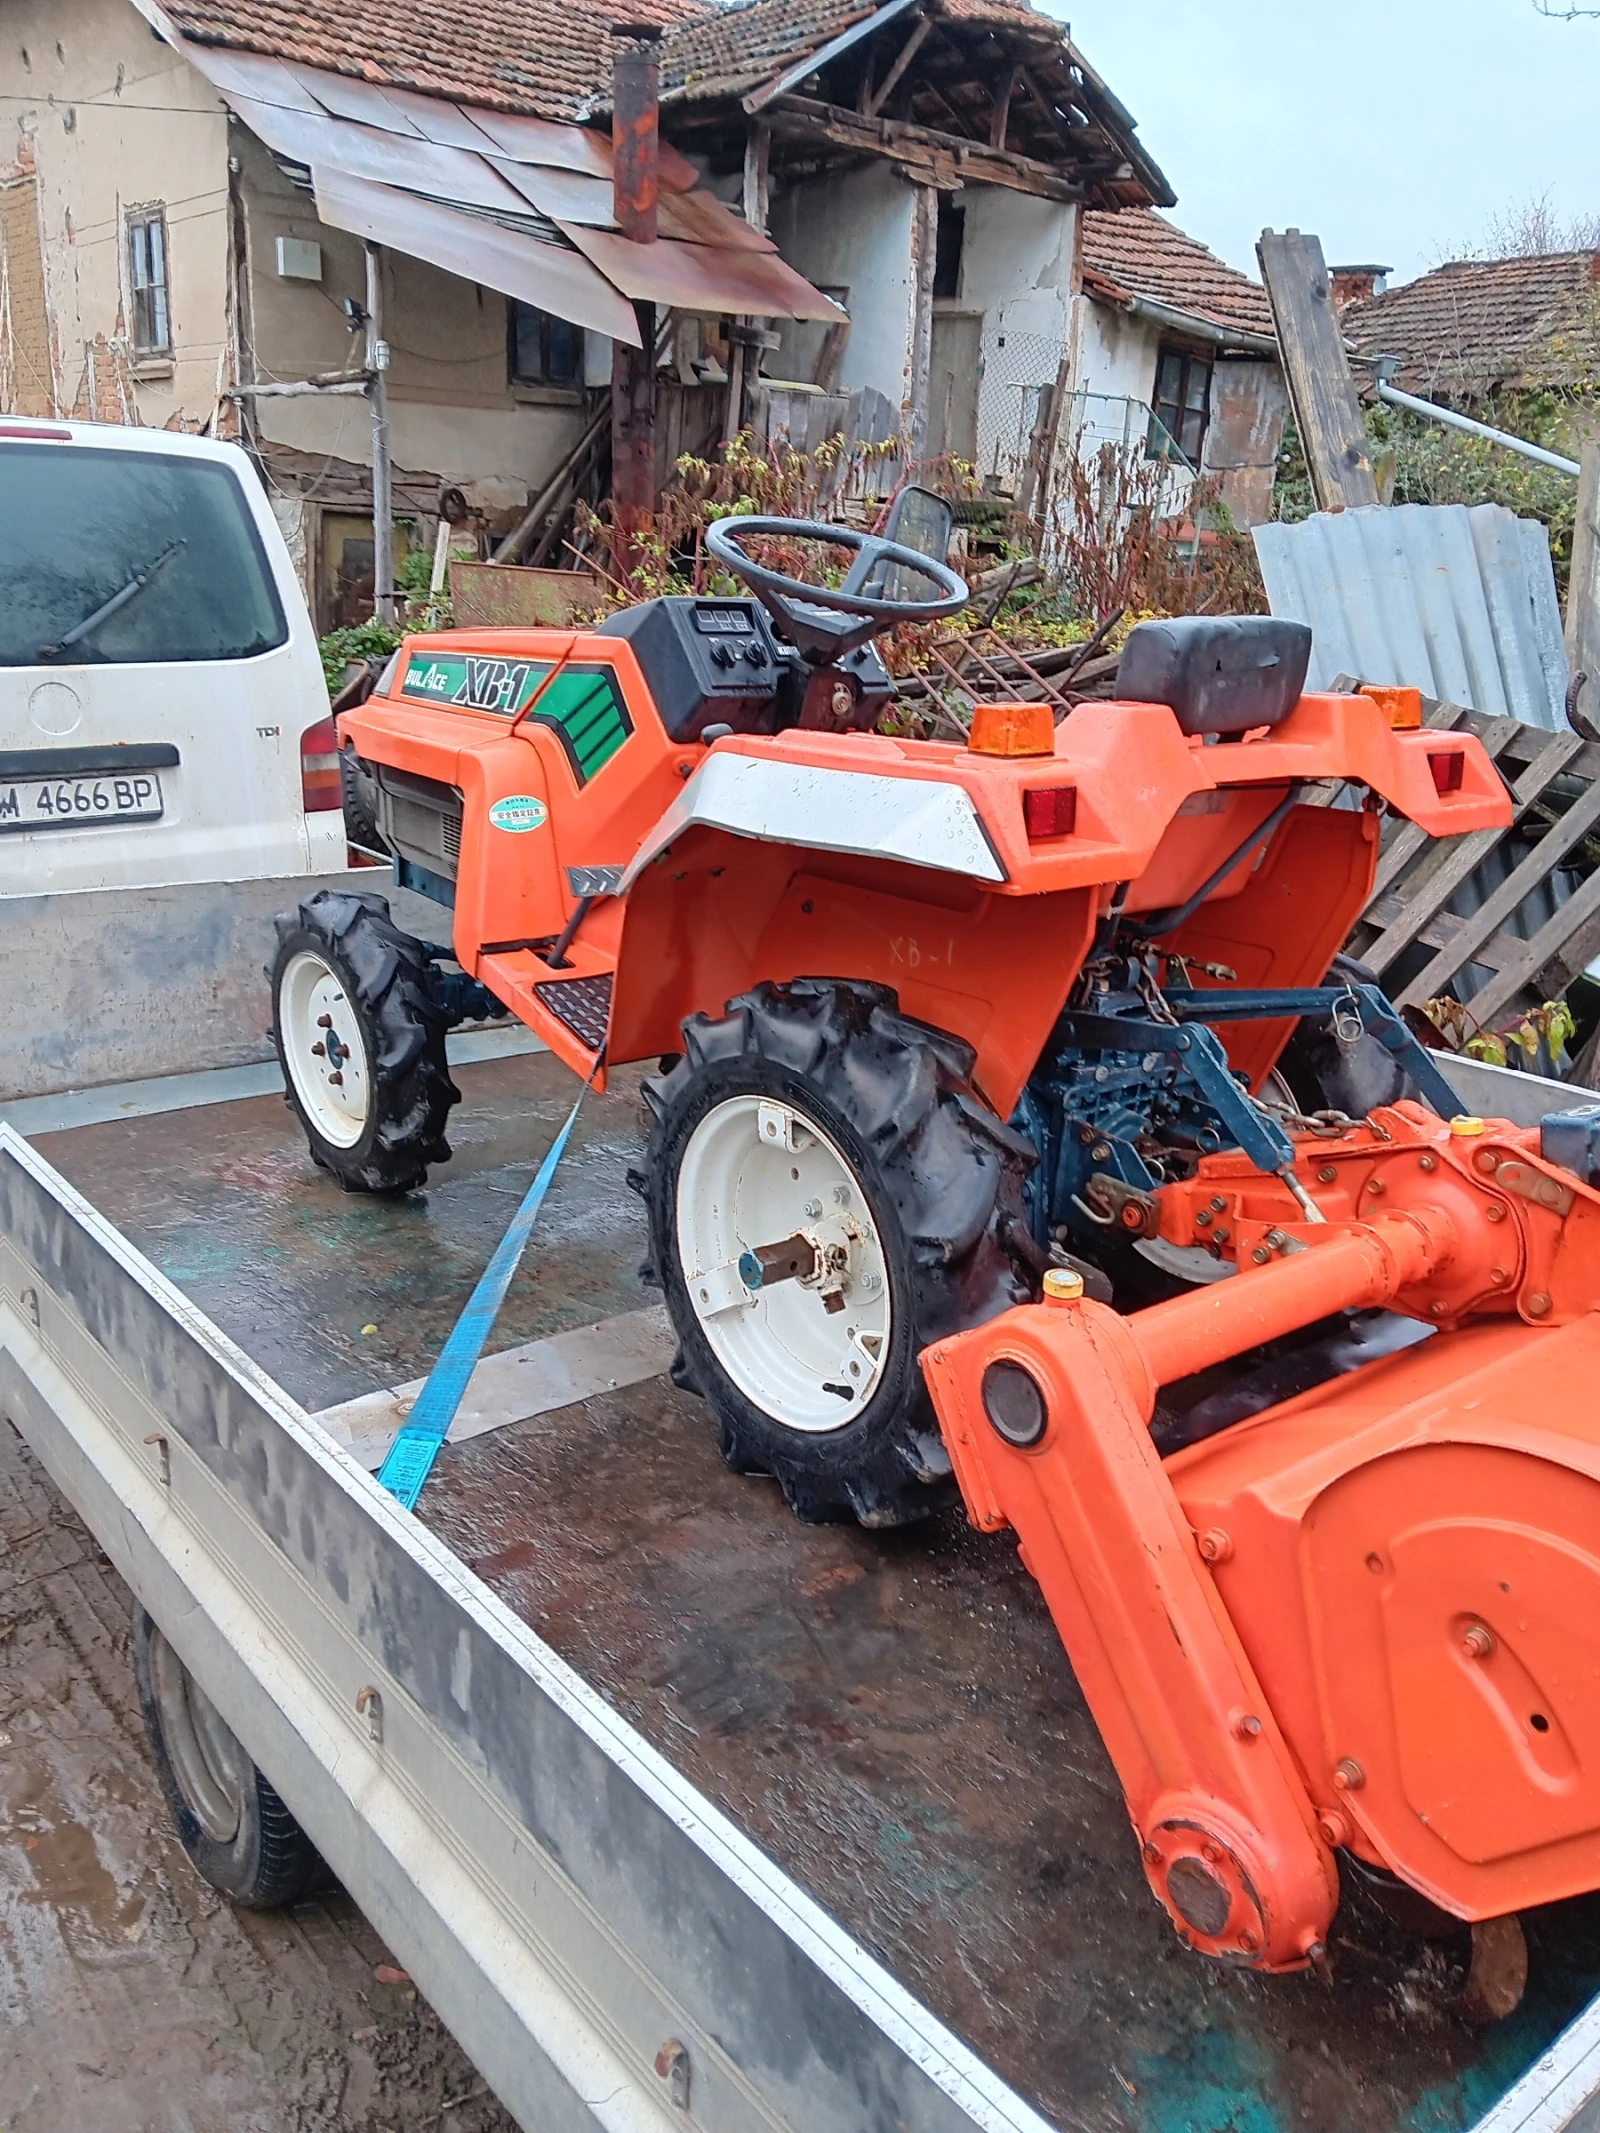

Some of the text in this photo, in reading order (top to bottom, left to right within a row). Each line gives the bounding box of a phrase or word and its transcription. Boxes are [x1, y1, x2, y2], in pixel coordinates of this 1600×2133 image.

[451, 657, 530, 713] XB-1
[255, 726, 280, 738] TDI
[37, 782, 109, 814] 4666
[114, 779, 152, 809] BP
